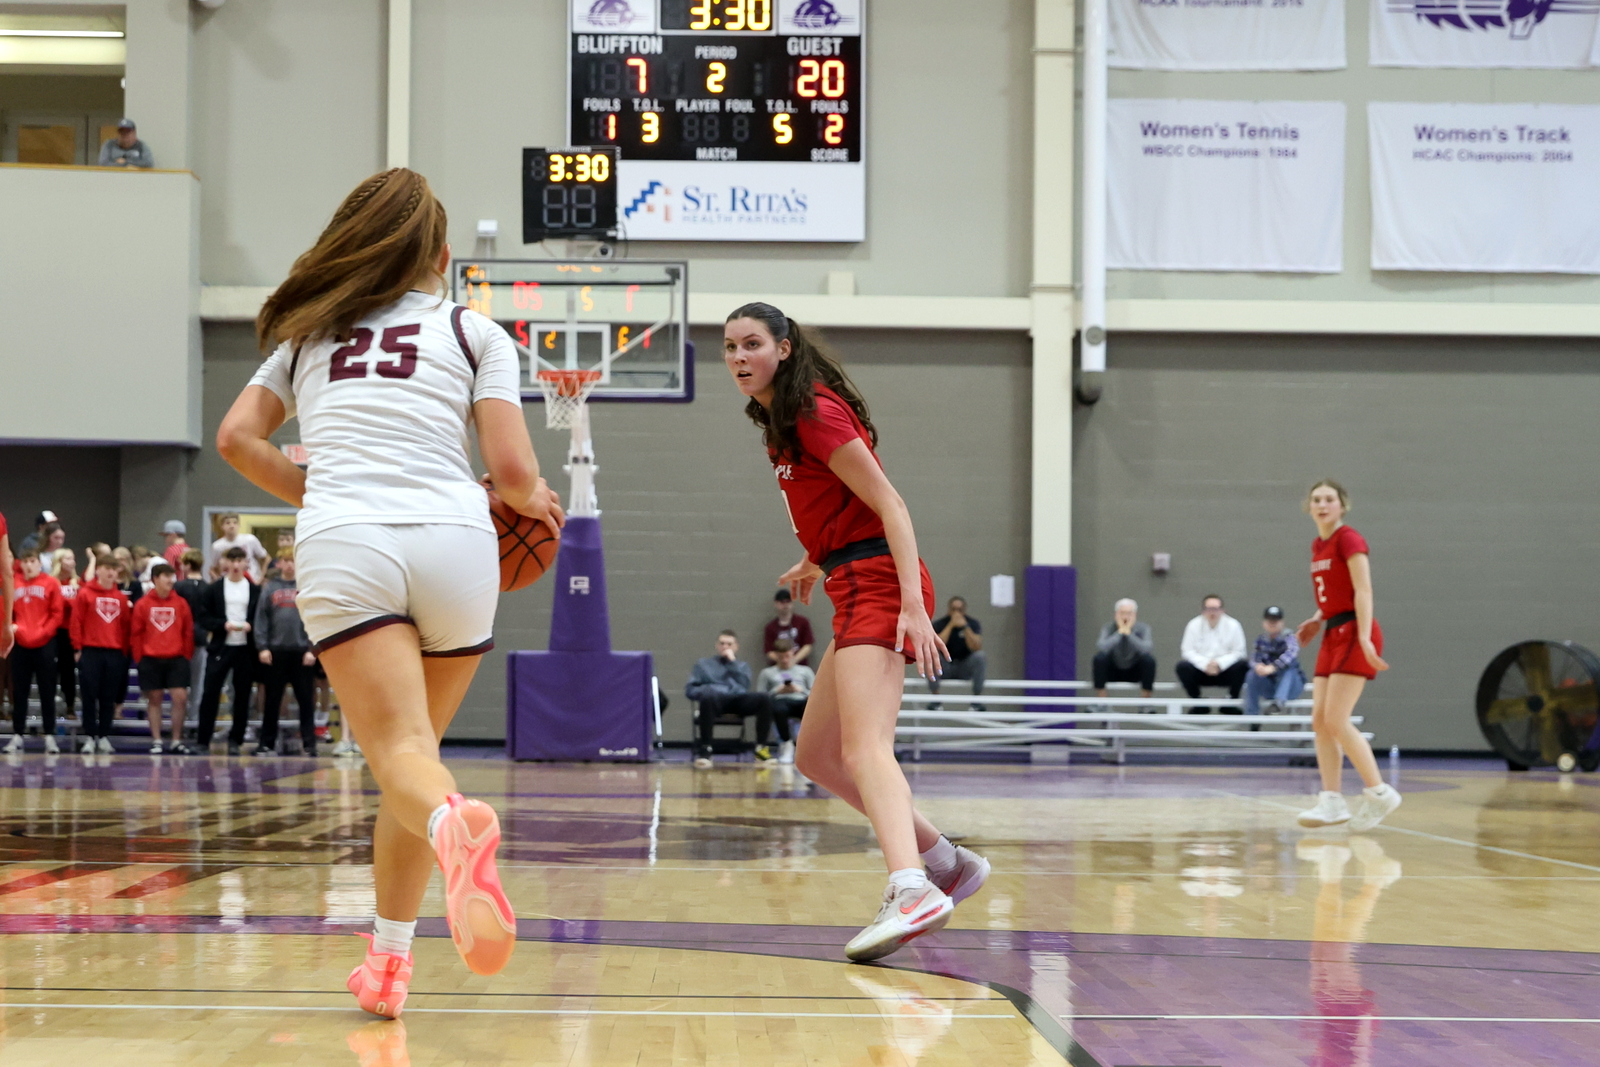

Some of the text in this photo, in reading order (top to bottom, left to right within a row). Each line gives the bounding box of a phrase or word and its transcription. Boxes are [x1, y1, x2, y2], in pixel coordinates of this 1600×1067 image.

[690, 0, 770, 31] 3:30
[577, 35, 663, 54] BLUFFTON
[695, 46, 737, 59] PERIOD
[787, 37, 843, 56] GUEST
[626, 58, 647, 94] 7
[706, 62, 726, 93] 2
[797, 59, 845, 98] 20
[583, 98, 621, 112] FOULS
[675, 98, 755, 113] PLAYER FOUL
[810, 100, 849, 113] FOULS
[607, 113, 616, 141] 1
[641, 112, 660, 143] 3
[772, 113, 793, 144] 5
[825, 114, 844, 144] 2
[1140, 121, 1299, 139] Women's Tennis
[1413, 125, 1570, 142] Women's Track
[549, 153, 609, 182] 3:30
[696, 148, 737, 161] MATCH
[811, 148, 849, 161] SCORE
[329, 323, 421, 382] 25
[1315, 576, 1327, 603] 2
